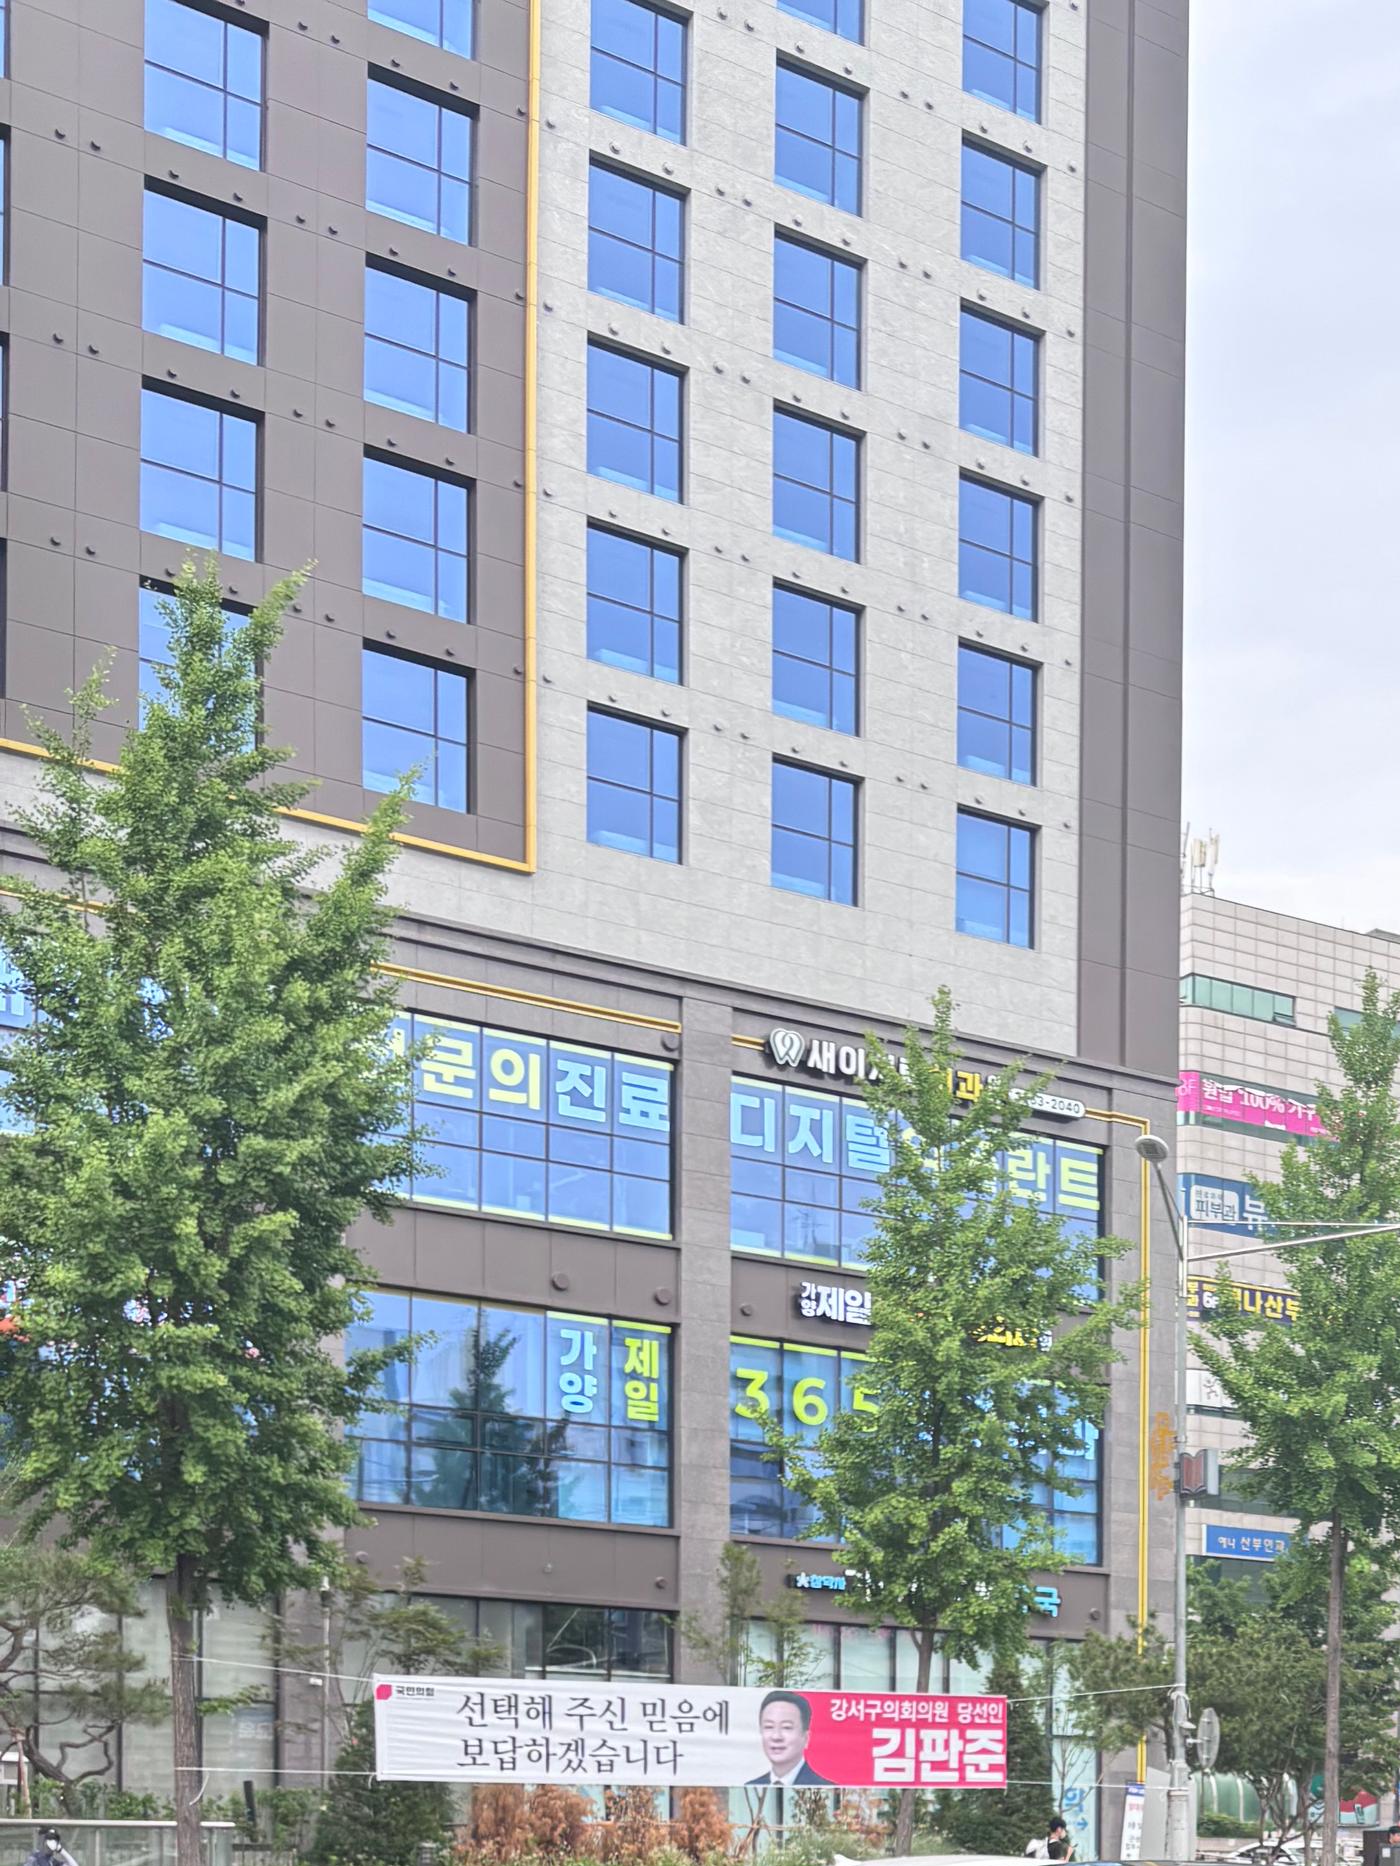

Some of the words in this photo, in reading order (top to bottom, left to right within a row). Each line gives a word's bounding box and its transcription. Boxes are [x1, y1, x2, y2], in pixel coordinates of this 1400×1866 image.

[396, 1686, 435, 1697] 국민의힘
[830, 1699, 949, 1723] 강서구의회의원
[957, 1702, 1003, 1724] 당선인
[456, 1691, 553, 1731] 선택해
[565, 1696, 628, 1732] 주신
[641, 1698, 730, 1736] 믿음에
[456, 1736, 685, 1777] 보답하겠습니다
[871, 1727, 1006, 1783] 김판준
